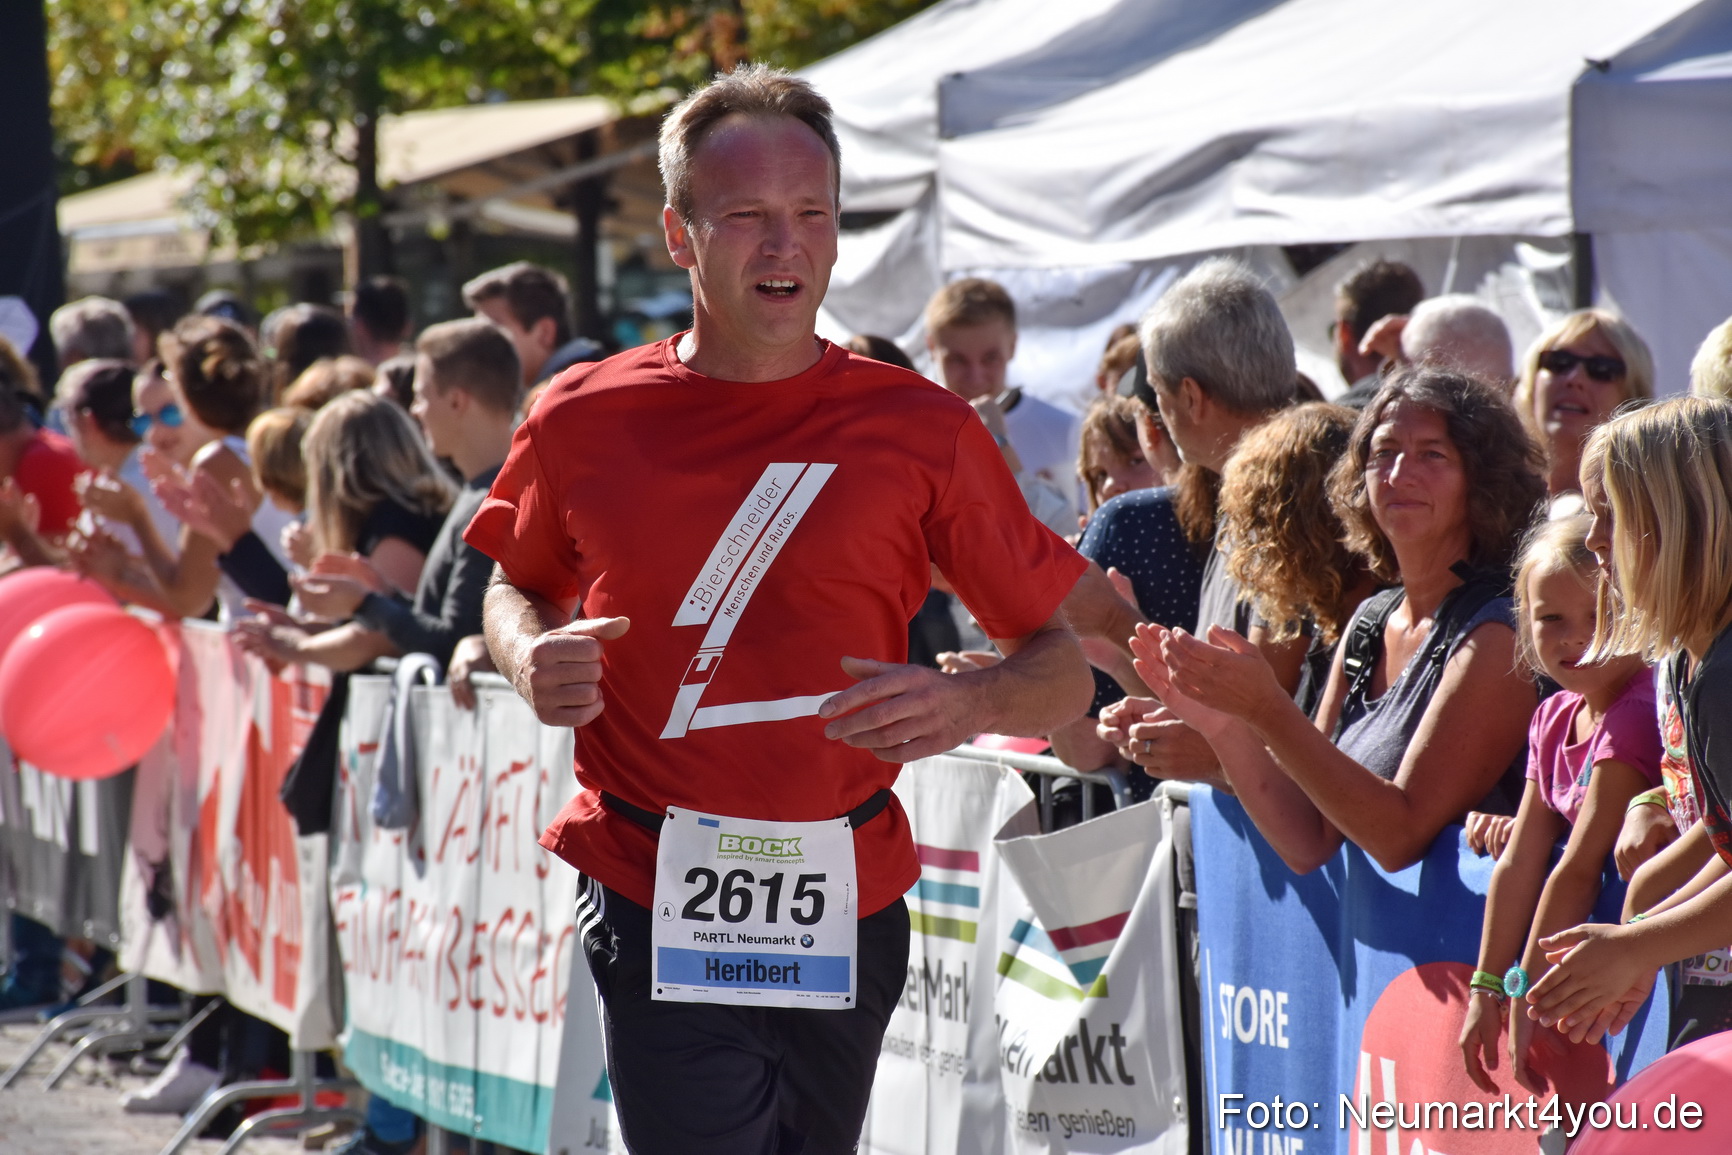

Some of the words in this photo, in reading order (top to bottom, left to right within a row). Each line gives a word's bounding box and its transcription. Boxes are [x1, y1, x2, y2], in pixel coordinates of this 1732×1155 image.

[723, 564, 761, 618] Menschen
[757, 542, 775, 564] und
[769, 511, 798, 543] Autos.
[716, 852, 744, 862] inspired
[718, 833, 803, 857] BOCK
[681, 867, 826, 926] 2615
[693, 931, 735, 944] PARTL
[737, 933, 796, 945] Neumarkt
[705, 957, 801, 985] Heribert
[1219, 982, 1290, 1049] STORE
[1058, 1109, 1136, 1139] genießen
